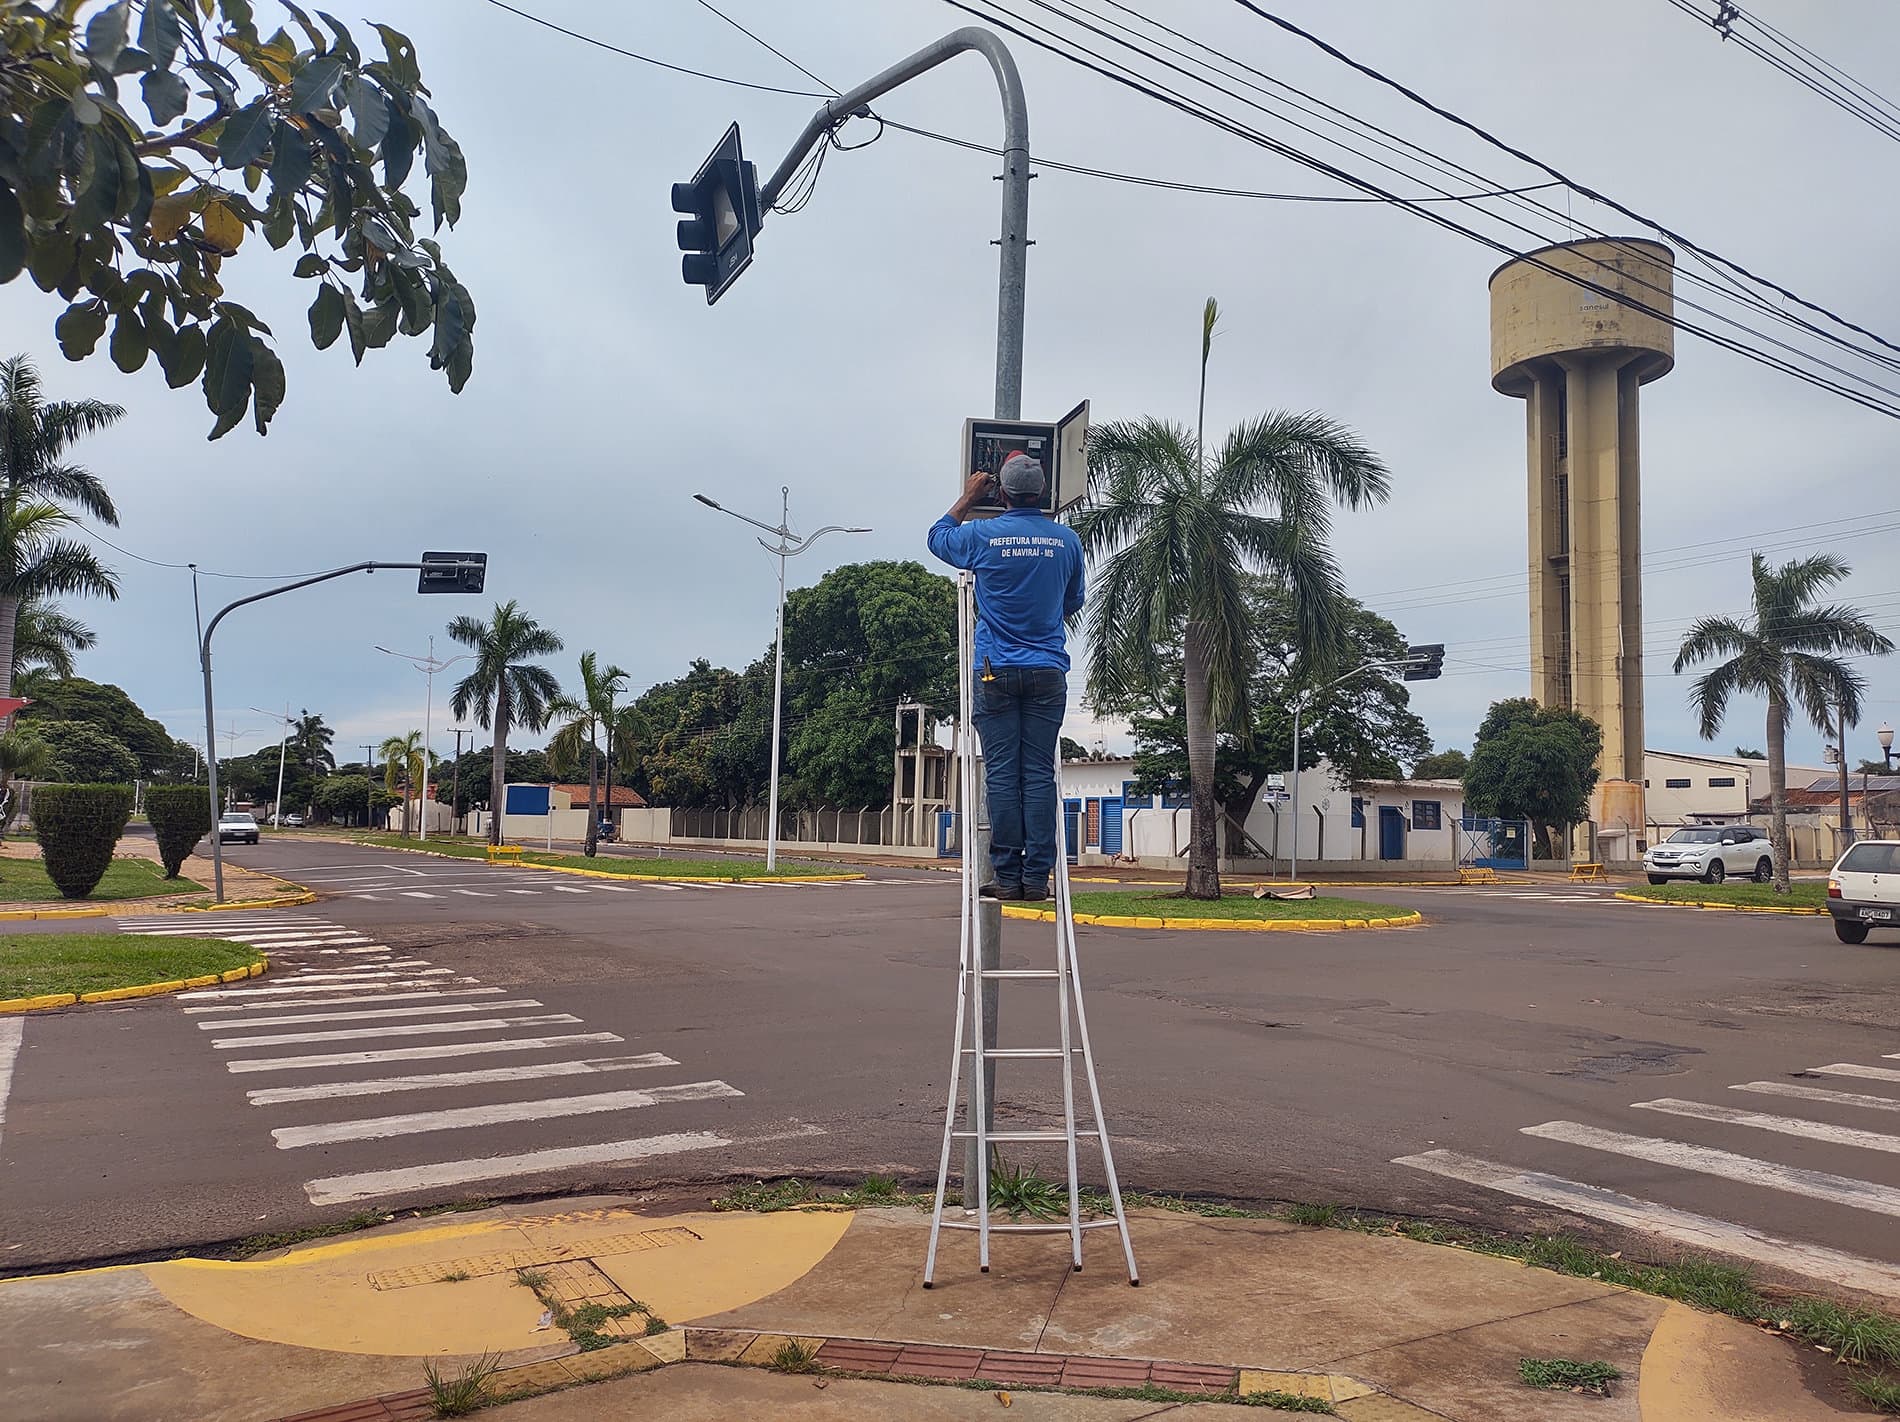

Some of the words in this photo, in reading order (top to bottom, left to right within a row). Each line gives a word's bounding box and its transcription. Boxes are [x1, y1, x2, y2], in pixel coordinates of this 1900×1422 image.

[989, 536, 1030, 547] PREFEITURA
[1031, 536, 1065, 548] MUNICIPAL
[1001, 549, 1011, 557] DE
[1012, 546, 1039, 557] NAVIRAÍ
[1044, 549, 1054, 557] MS
